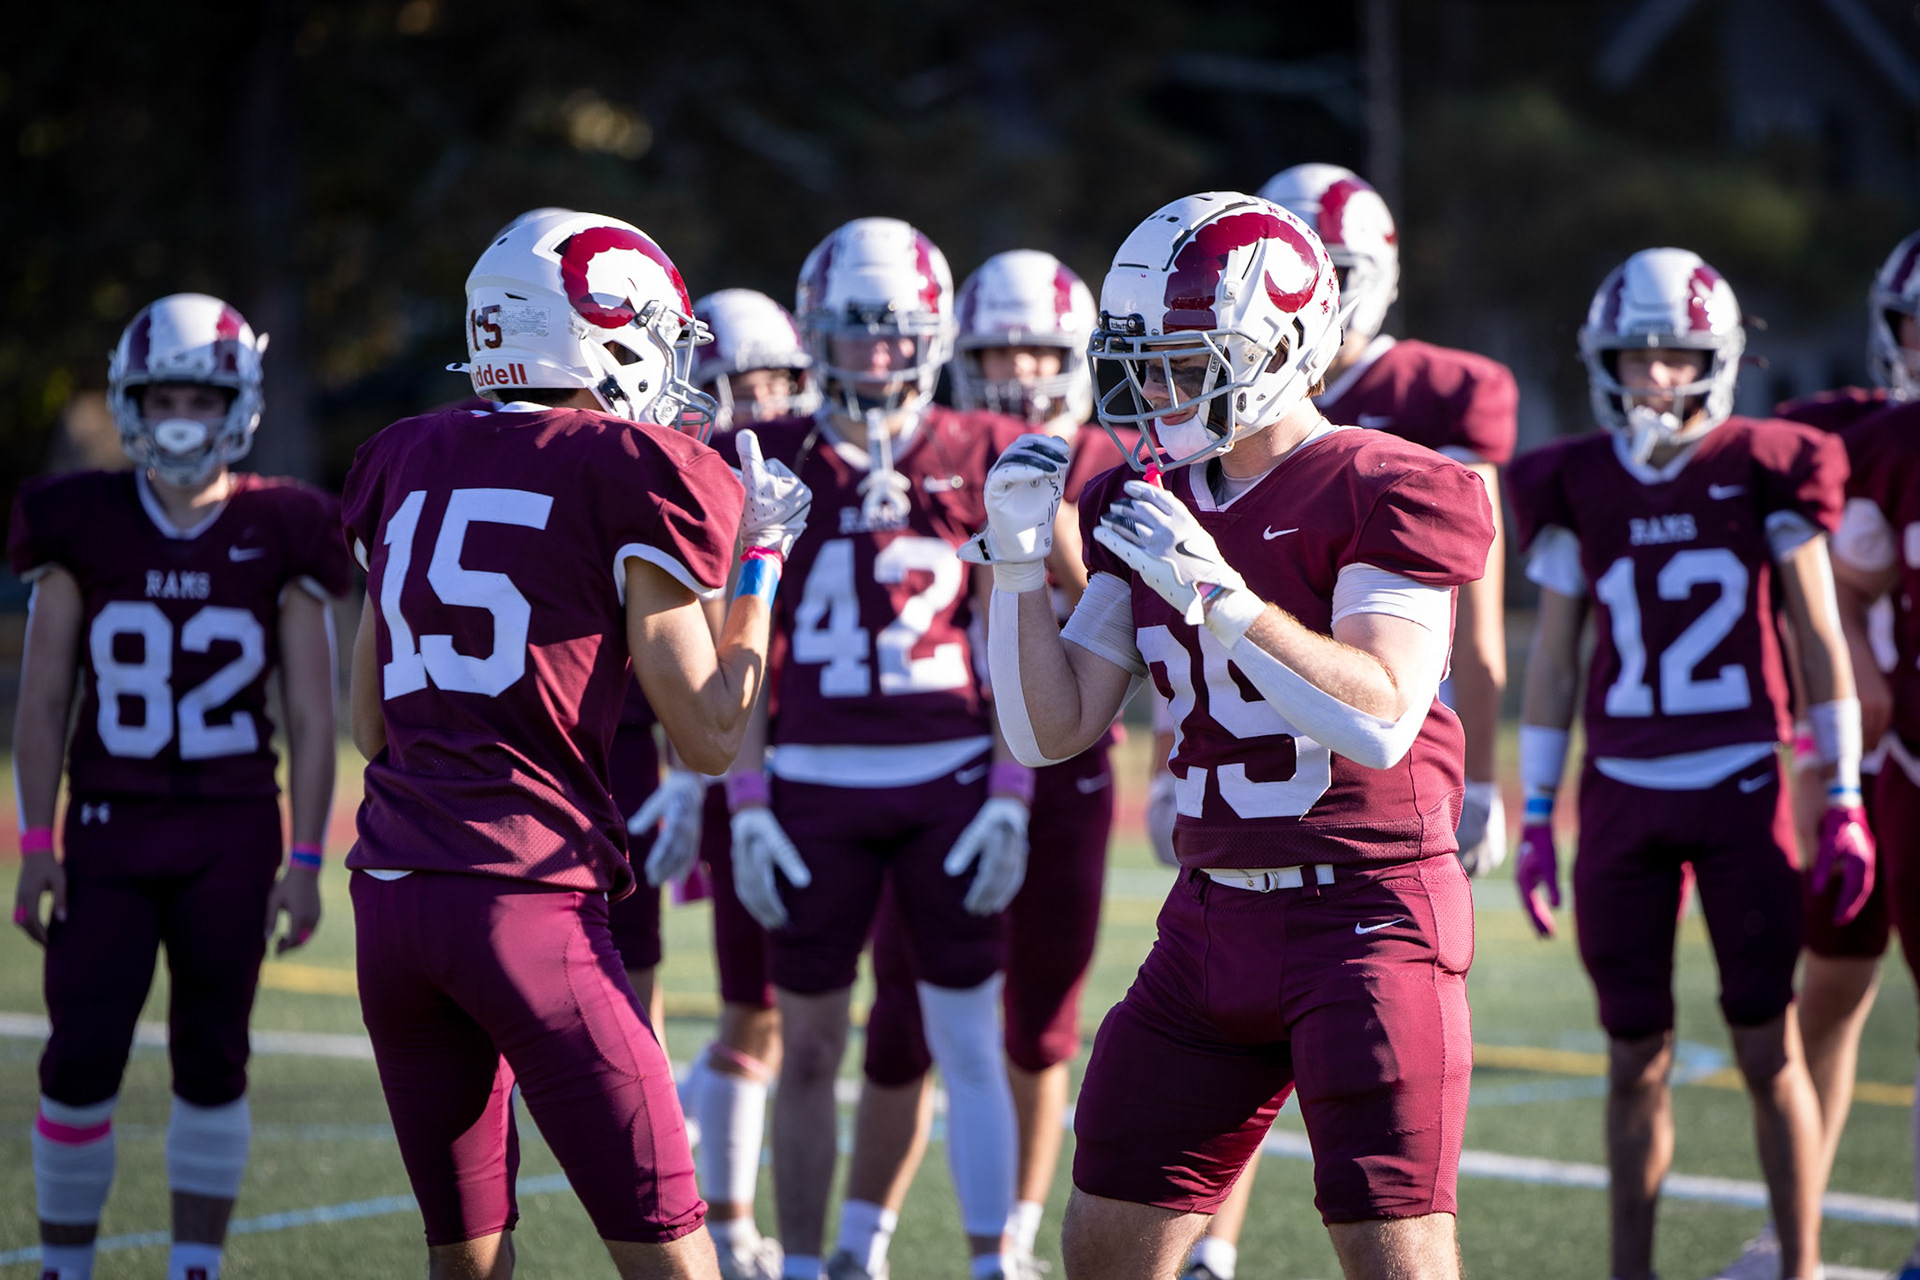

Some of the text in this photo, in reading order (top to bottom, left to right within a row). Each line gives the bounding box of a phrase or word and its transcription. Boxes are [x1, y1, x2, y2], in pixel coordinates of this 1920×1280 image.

[471, 304, 502, 351] 15
[145, 569, 211, 599] RAMS
[380, 487, 554, 701] 15
[1628, 513, 1698, 546] RAMS
[89, 600, 266, 761] 82
[793, 535, 969, 698] 42
[1595, 547, 1752, 718] 12
[1136, 624, 1332, 821] 29
